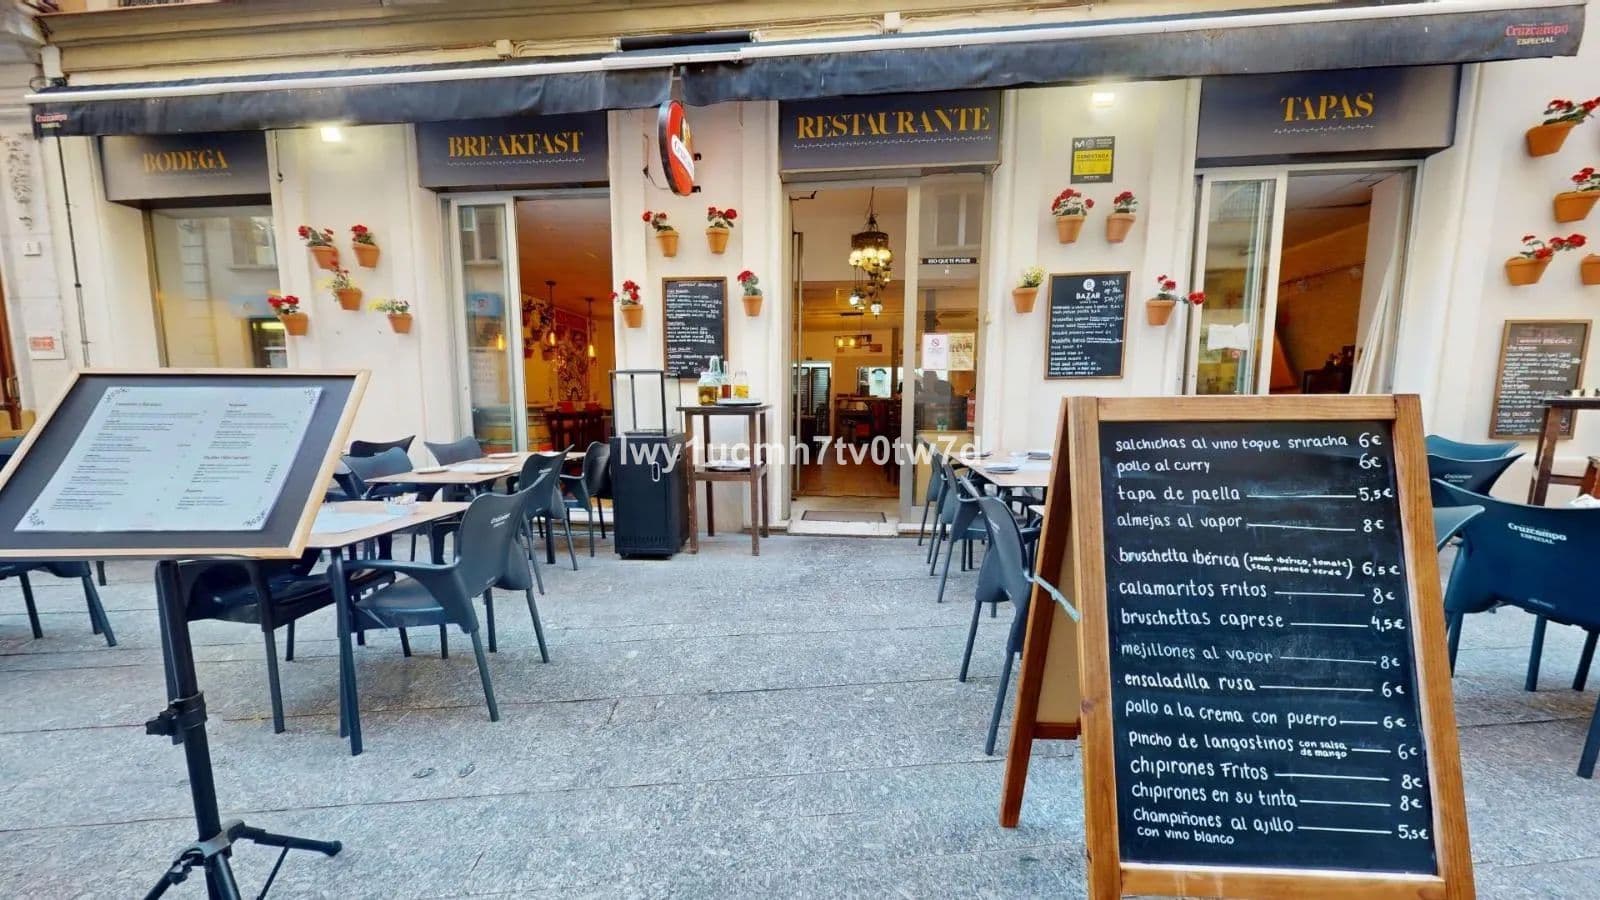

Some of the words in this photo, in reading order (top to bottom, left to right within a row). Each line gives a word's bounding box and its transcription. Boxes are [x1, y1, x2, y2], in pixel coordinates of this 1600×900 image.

[1504, 22, 1568, 36] Cruzcampo
[1516, 36, 1555, 46] ESPECIAL
[1281, 92, 1374, 122] TAPAS
[797, 105, 991, 140] RESTAURANTE
[448, 130, 583, 158] BREAKFAST
[142, 150, 229, 175] BODEGA
[1116, 437, 1186, 452] salchichas
[1192, 437, 1207, 449] al
[1212, 440, 1238, 449] vino
[1242, 438, 1280, 452] toque
[1288, 435, 1348, 448] sriracha
[1359, 432, 1382, 448] 6€
[1117, 461, 1150, 478] pollo
[1155, 459, 1170, 471] al
[1174, 461, 1210, 473] curry
[1359, 453, 1381, 469] 6€
[1117, 485, 1156, 502] tapa
[1164, 486, 1184, 500] de
[1192, 486, 1240, 504] paella
[1358, 487, 1393, 501] 5,5€
[1117, 513, 1170, 530] almejas
[1177, 513, 1194, 528] al
[1200, 517, 1242, 532] vapor
[1363, 519, 1384, 532] 8€
[1508, 522, 1567, 541] Cruzcampo
[1119, 547, 1189, 563] bruschetta
[1192, 549, 1240, 568] ibérica
[1362, 562, 1400, 577] 6,5€
[1119, 579, 1214, 597] calamaritos
[1373, 587, 1395, 604] 8€
[1121, 608, 1211, 625] bruschettas
[1220, 614, 1284, 630] caprese
[1371, 616, 1405, 632] 4,5€
[1121, 643, 1195, 660] mejillones
[1203, 646, 1220, 659] al
[1226, 650, 1273, 663] vapor
[1381, 656, 1400, 669] 8€
[1125, 672, 1210, 689] ensaladilla
[1218, 677, 1256, 691] rusa
[1382, 682, 1404, 697] 6€
[1126, 699, 1158, 717] pollo
[1164, 704, 1174, 716] a
[1177, 702, 1195, 718] la
[1199, 707, 1244, 722] crema
[1252, 712, 1277, 724] con
[1287, 712, 1337, 729] puerro
[1383, 716, 1406, 729] 6€
[1129, 731, 1172, 747] pincho
[1178, 733, 1198, 748] de
[1204, 734, 1293, 752] langostinos
[1299, 741, 1317, 749] con
[1320, 741, 1347, 750] salsa
[1398, 744, 1418, 760] 6€
[1300, 746, 1312, 756] de
[1314, 750, 1347, 759] mango
[1130, 755, 1215, 779] chipirones
[1401, 774, 1423, 790] 8€
[1132, 781, 1207, 803] chipirones
[1212, 789, 1228, 803] en
[1235, 791, 1253, 804] su
[1258, 789, 1298, 807] tinta
[1400, 795, 1423, 811] 8€
[1133, 806, 1222, 828] champiñones
[1231, 816, 1247, 830] al
[1253, 818, 1293, 834] ajillo
[1398, 824, 1429, 840] 5,5€
[1137, 826, 1159, 837] con
[1164, 830, 1190, 840] vino
[1194, 830, 1234, 844] blanco
